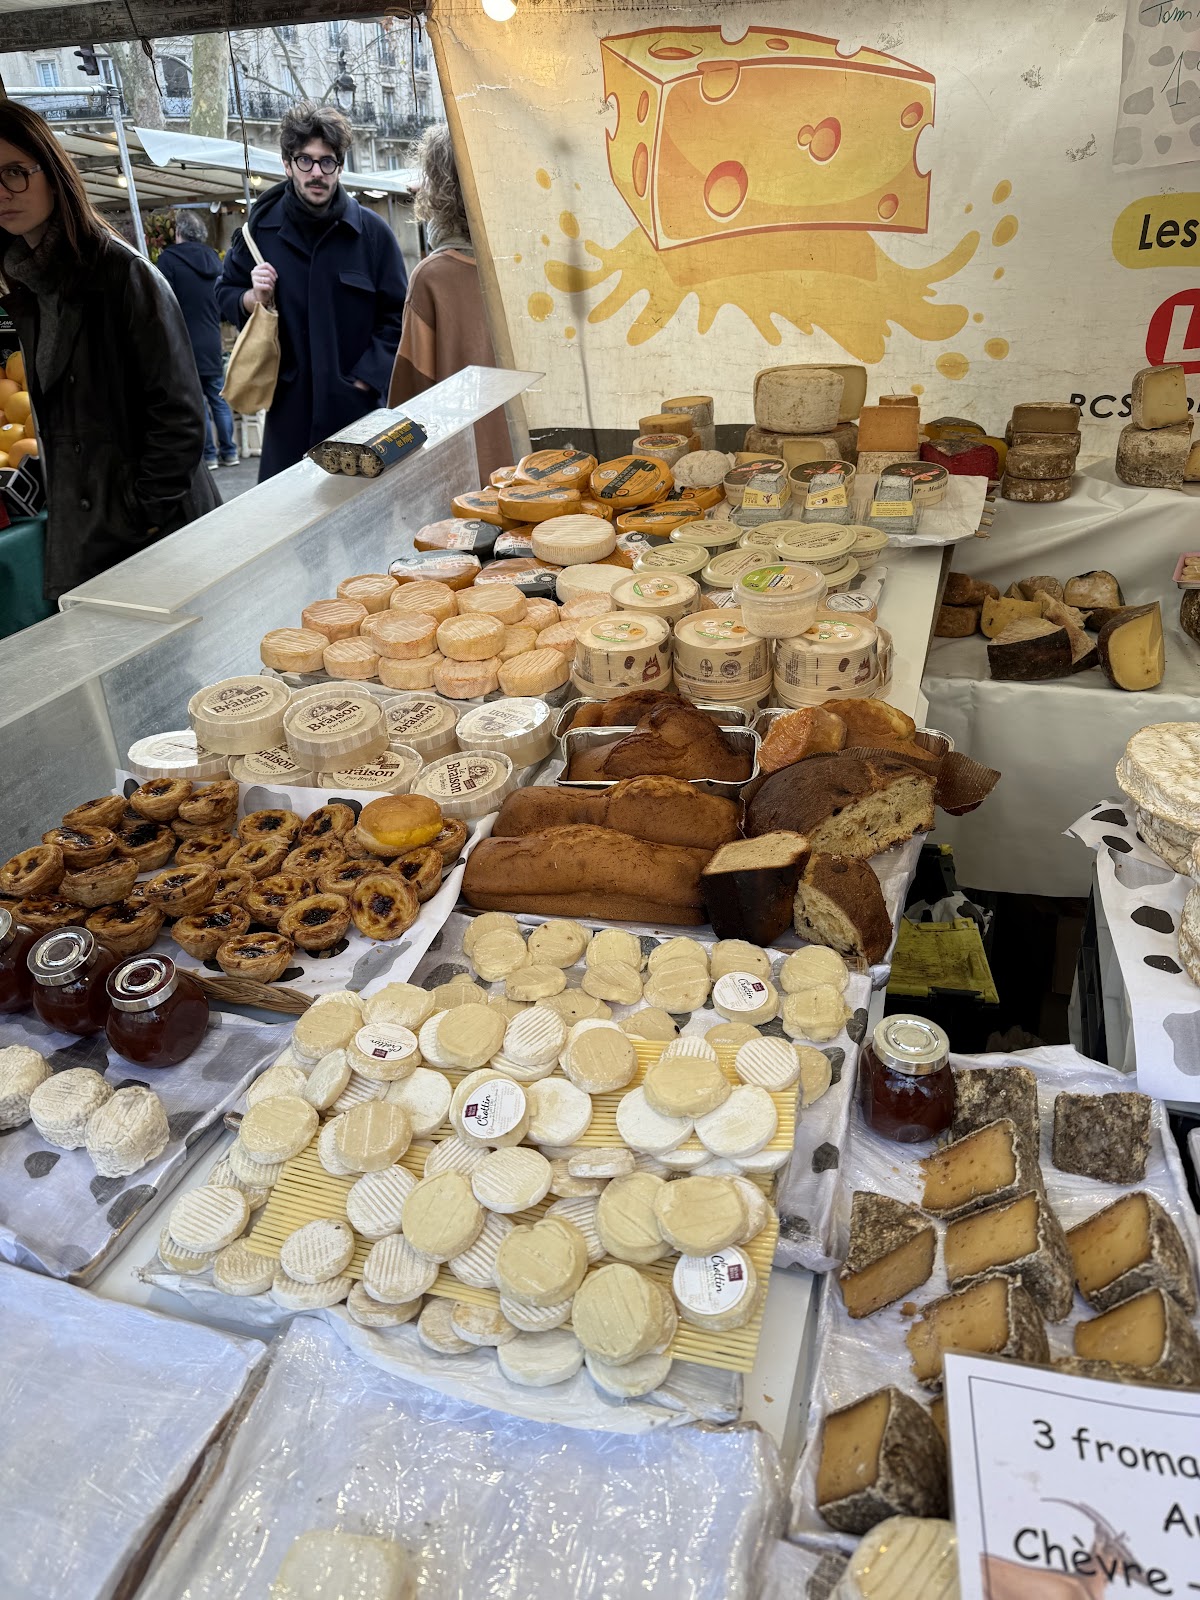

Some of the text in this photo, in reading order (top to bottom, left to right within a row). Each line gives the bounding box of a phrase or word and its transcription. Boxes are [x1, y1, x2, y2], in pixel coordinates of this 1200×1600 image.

[1138, 214, 1200, 250] Les
[211, 690, 270, 714] Braison
[306, 705, 362, 733] Braison
[393, 705, 437, 734] Braison
[255, 750, 296, 771] raison
[446, 762, 462, 795] Braison
[370, 1039, 403, 1053] Crottin
[476, 1094, 491, 1127] Crottin
[710, 1255, 726, 1294] Crottin
[1033, 1419, 1200, 1480] 3 froma
[1013, 1527, 1174, 1596] Chèvre
